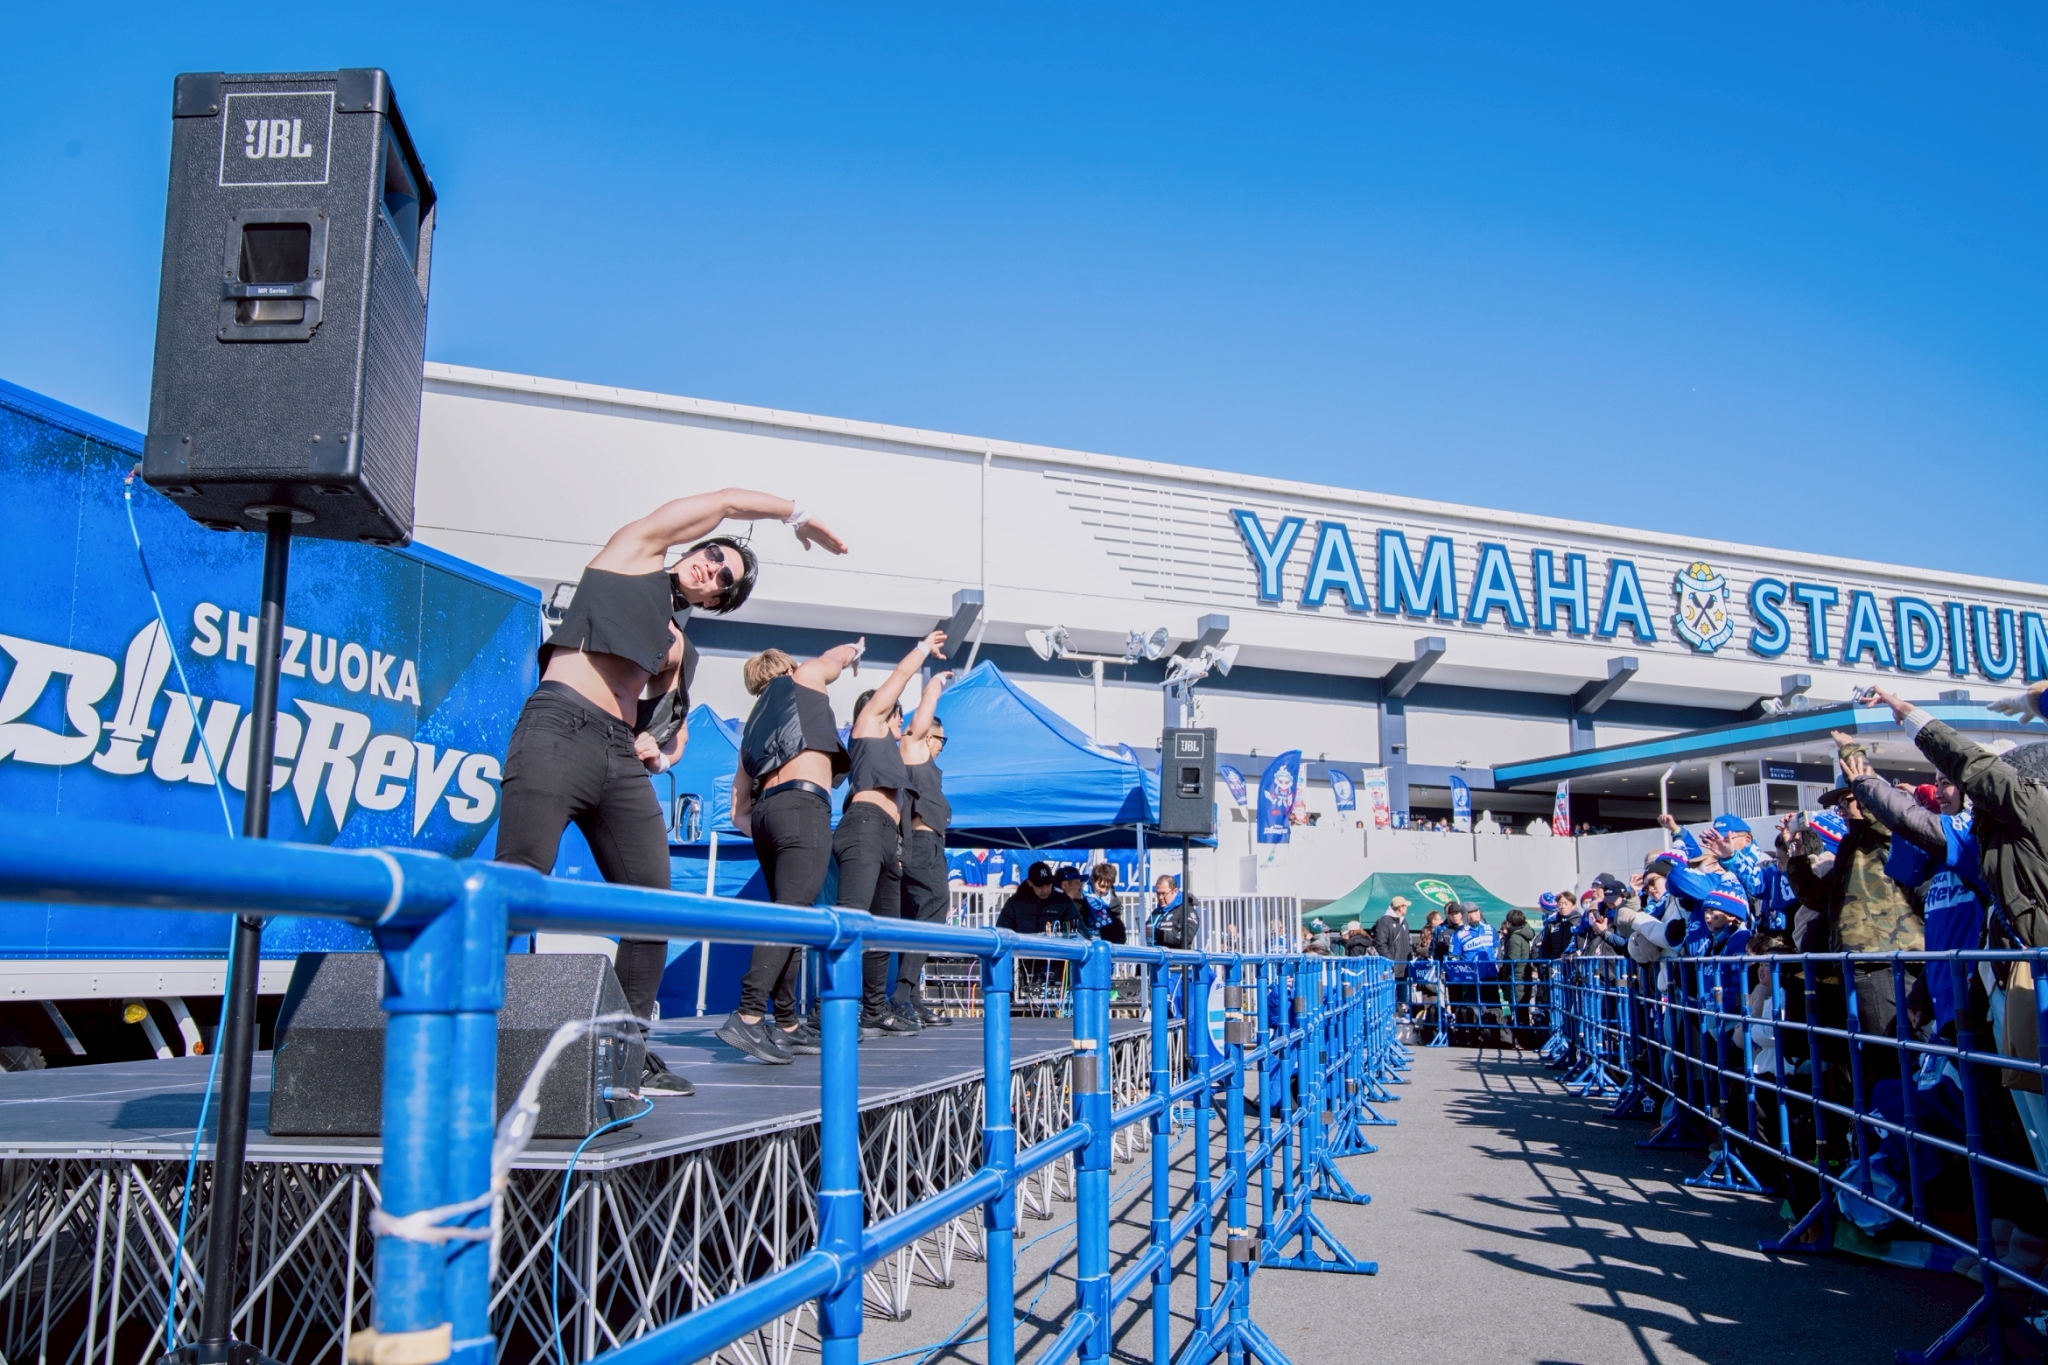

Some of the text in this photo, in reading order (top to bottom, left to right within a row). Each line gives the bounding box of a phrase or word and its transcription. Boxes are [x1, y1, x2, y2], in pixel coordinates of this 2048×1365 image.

[245, 119, 312, 159] JBL
[1229, 509, 1658, 642] YAMAHA
[190, 602, 421, 706] SHZUOKA
[1181, 740, 1200, 752] JBL
